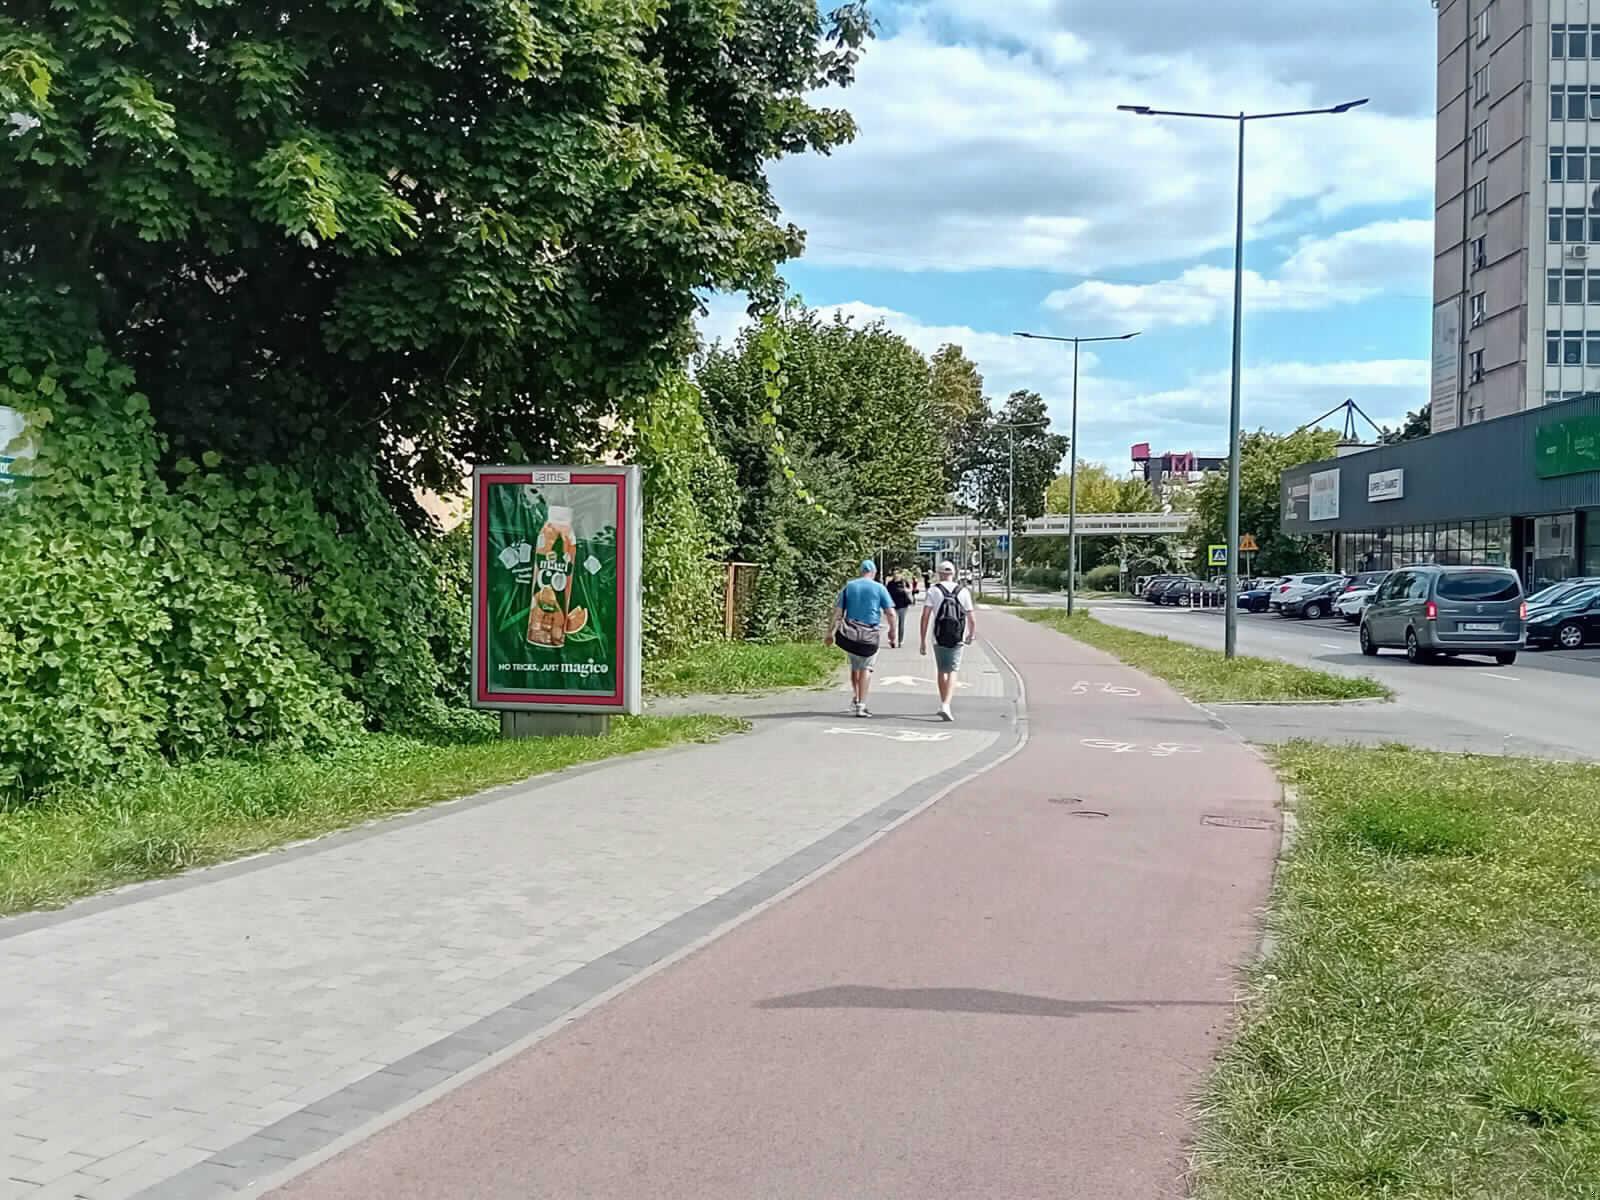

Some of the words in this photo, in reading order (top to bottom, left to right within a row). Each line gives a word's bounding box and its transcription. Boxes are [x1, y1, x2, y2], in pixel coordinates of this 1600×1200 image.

[537, 472, 565, 482] ams
[498, 663, 511, 671] NO
[512, 663, 539, 672] TRICKS,
[541, 663, 560, 672] JUST
[560, 658, 609, 677] magico
